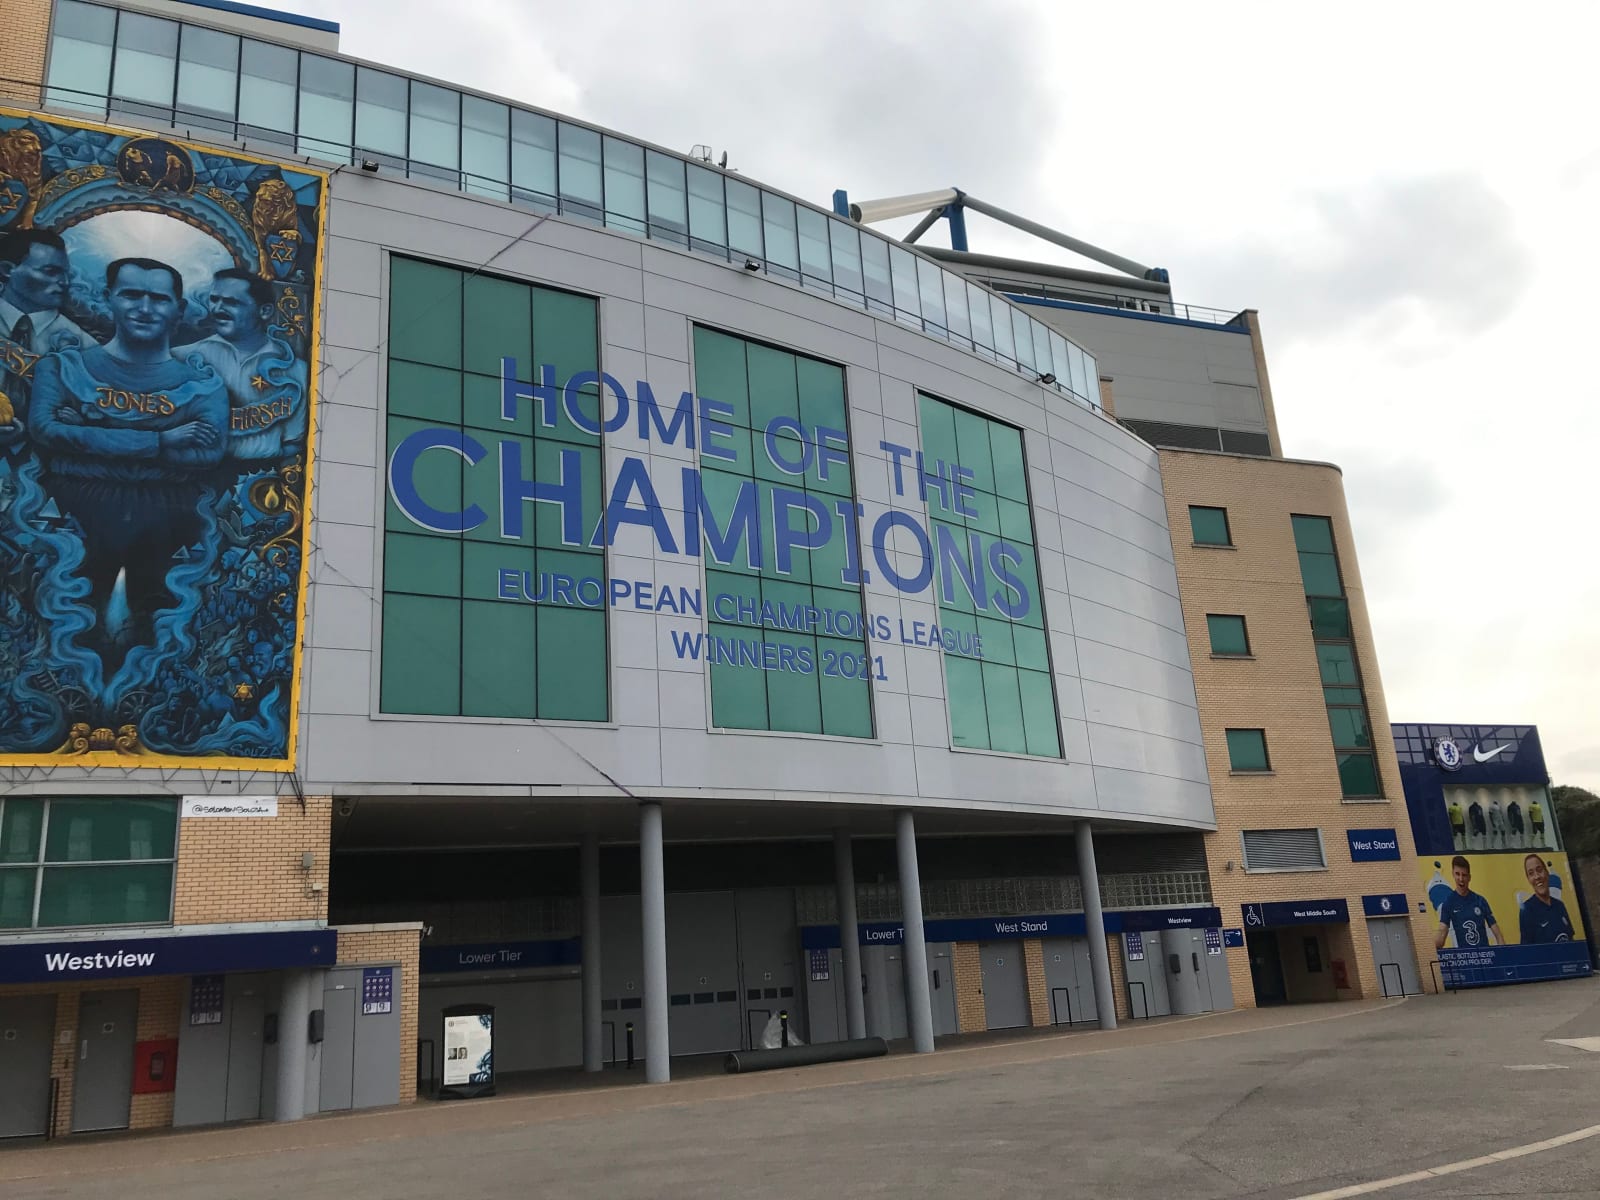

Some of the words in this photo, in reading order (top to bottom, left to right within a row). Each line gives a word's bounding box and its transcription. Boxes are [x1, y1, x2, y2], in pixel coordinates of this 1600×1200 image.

[96, 387, 176, 416] JONES
[231, 397, 292, 431] HIRSCH
[500, 356, 737, 462] HOME
[763, 415, 850, 482] OF
[878, 440, 979, 520] THE
[388, 427, 1031, 621] CHAMPIONS
[498, 568, 702, 616] EUROPEAN
[713, 593, 892, 641] CHAMPIONS
[899, 618, 985, 658] LEAGUE
[670, 630, 815, 675] WINNERS
[823, 650, 889, 682] 2021
[1352, 841, 1373, 850] West
[1373, 840, 1396, 850] Stand
[866, 929, 896, 940] Lower
[994, 922, 1018, 933] West
[1020, 920, 1048, 932] Stand
[45, 950, 155, 972] Westview
[459, 952, 496, 964] Lower
[498, 950, 522, 962] Tier
